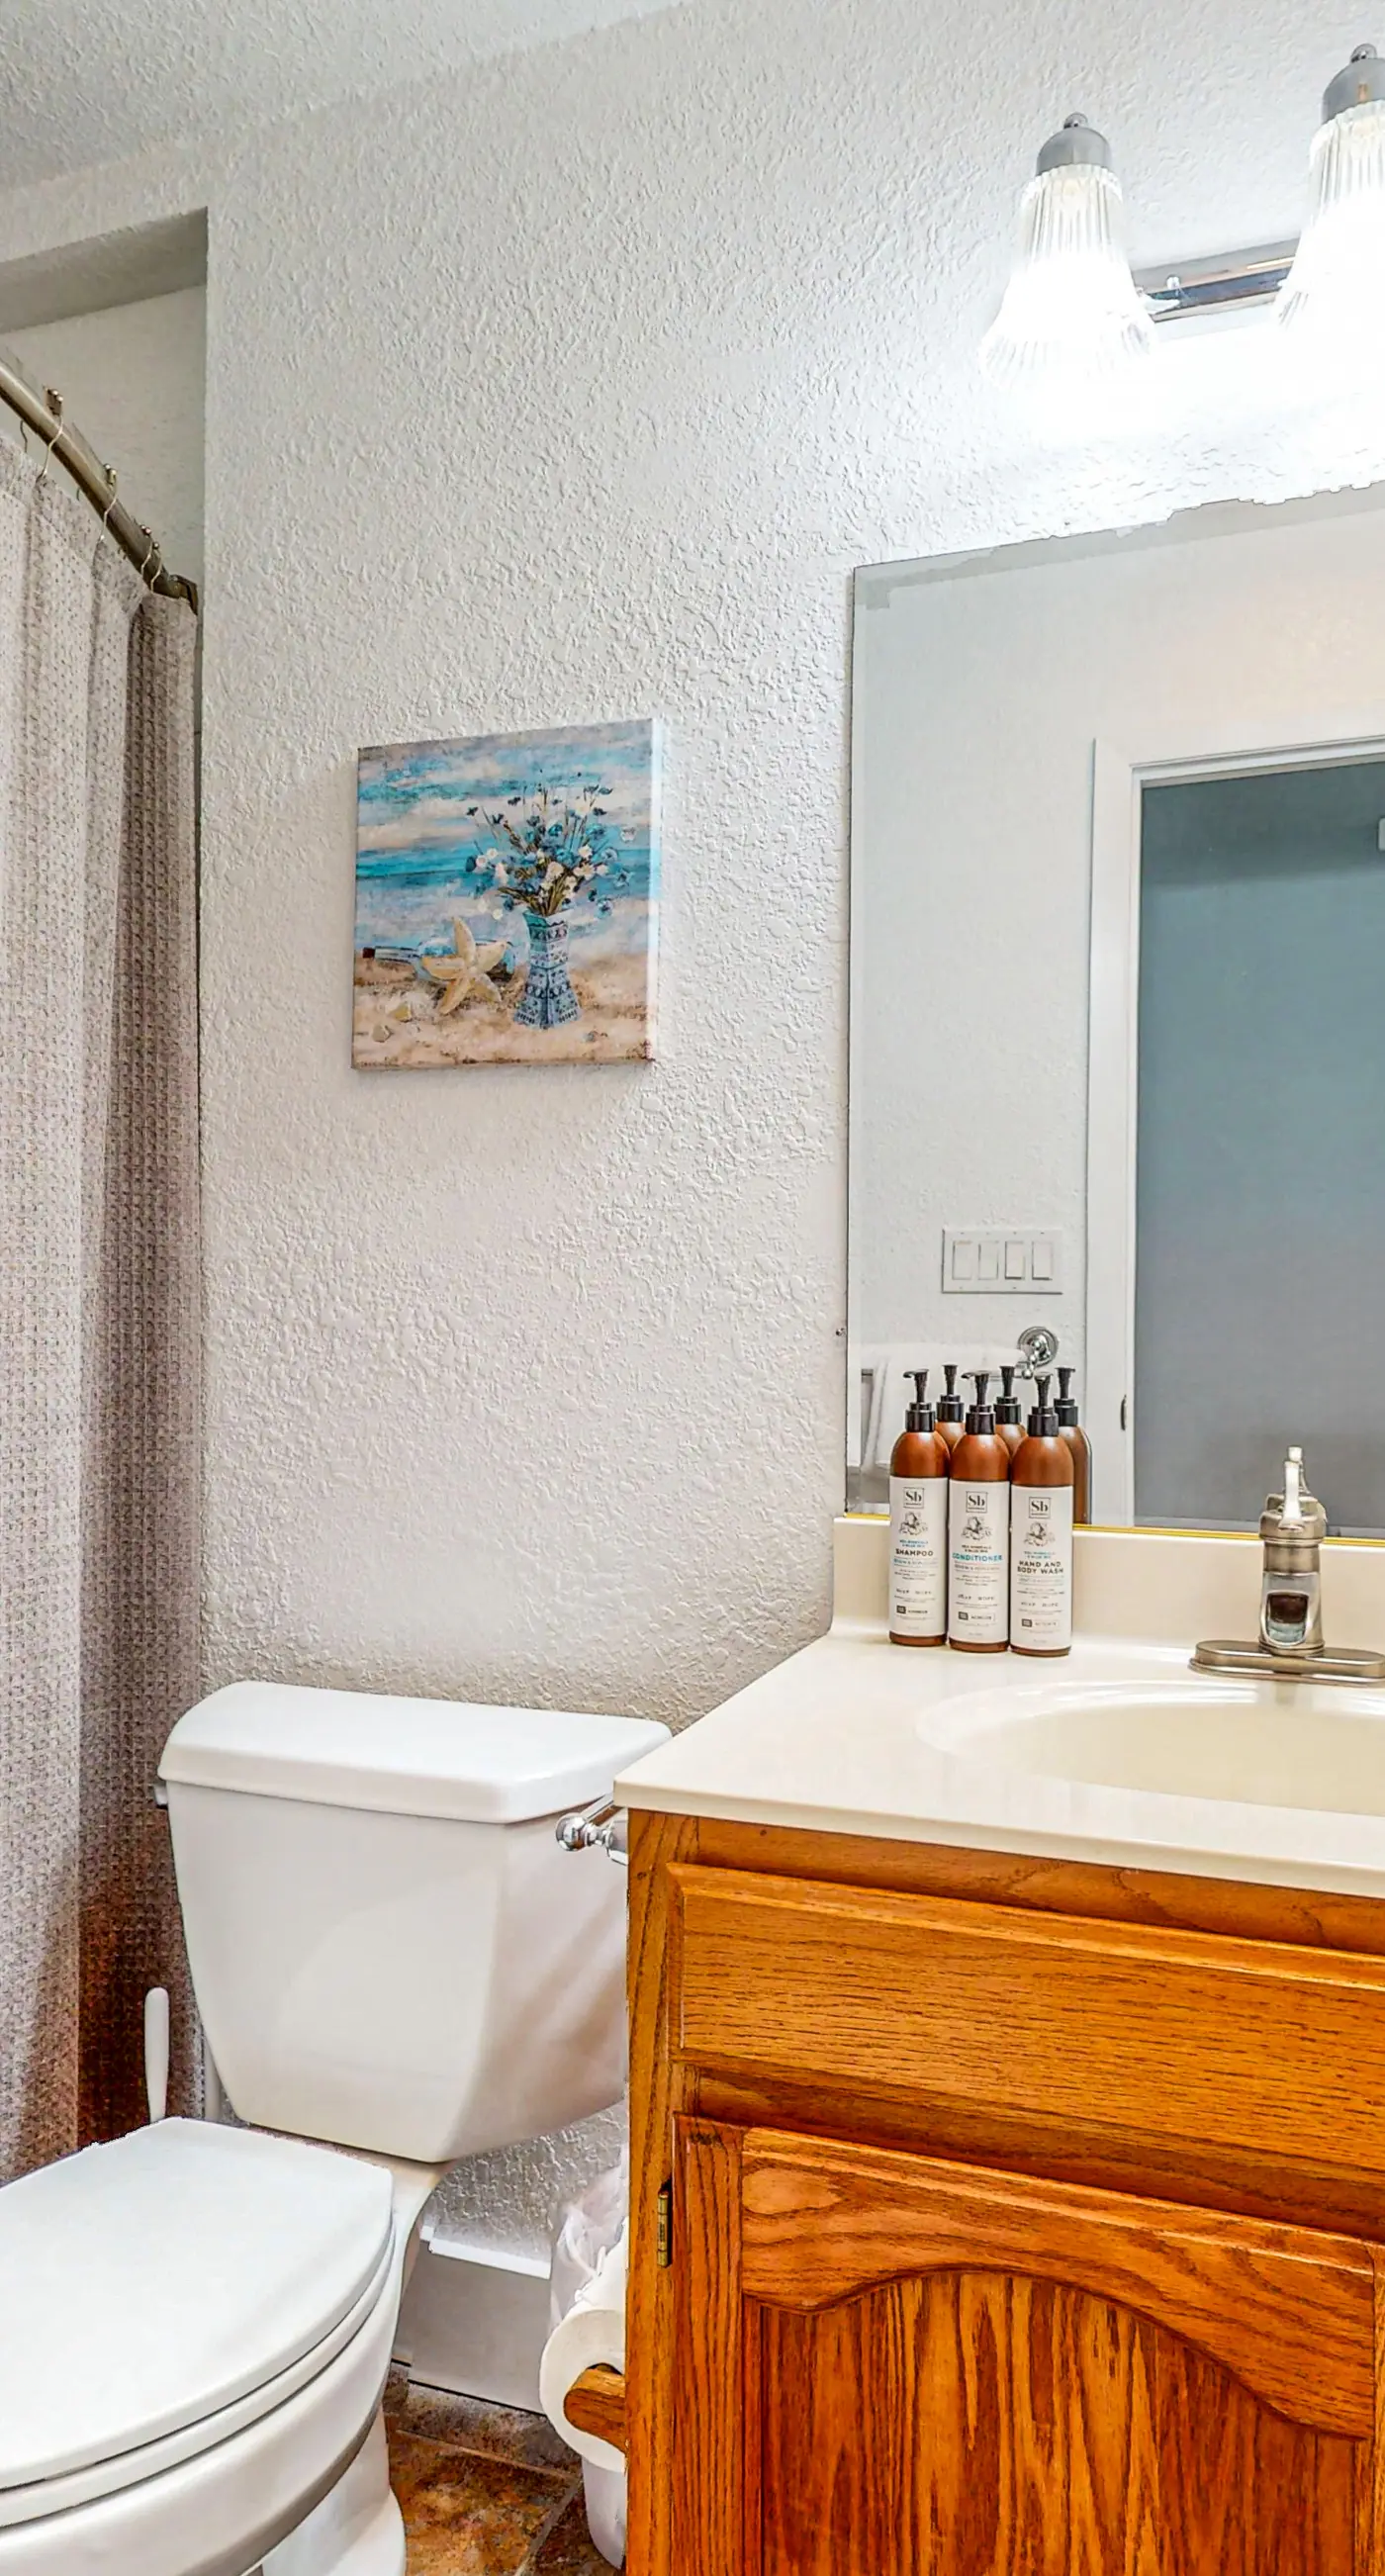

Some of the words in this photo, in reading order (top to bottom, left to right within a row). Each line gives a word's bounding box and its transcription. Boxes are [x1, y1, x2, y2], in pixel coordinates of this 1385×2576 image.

[968, 1495, 985, 1507] Sb
[1031, 1500, 1049, 1512] Sb
[895, 1548, 934, 1557] SHAMPOO
